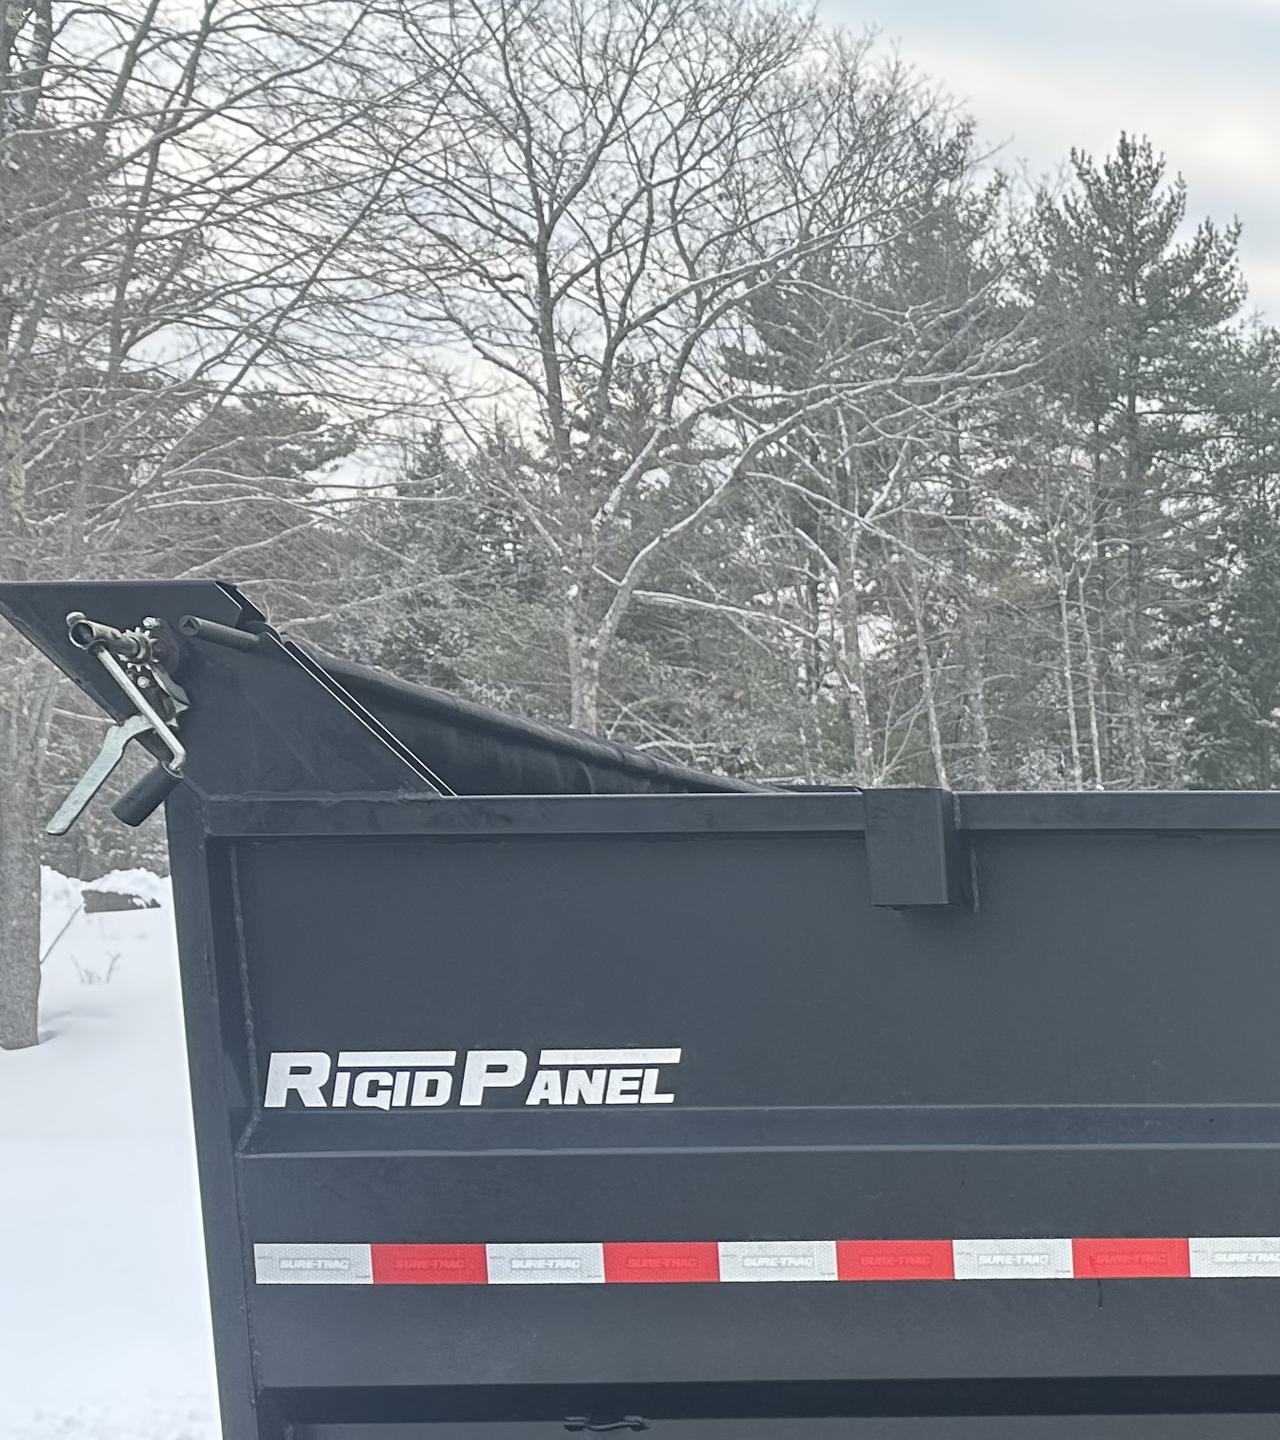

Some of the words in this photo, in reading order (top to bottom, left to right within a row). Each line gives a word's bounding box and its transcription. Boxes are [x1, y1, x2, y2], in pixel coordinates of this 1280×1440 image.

[264, 1050, 456, 1110] RIGID
[460, 1048, 681, 1107] PANEL
[280, 1259, 349, 1270] SURE-TRAC
[511, 1258, 580, 1269] SURE-TRAC
[743, 1256, 813, 1267] SURE-TRAC
[979, 1254, 1048, 1265] SURE-TRAC
